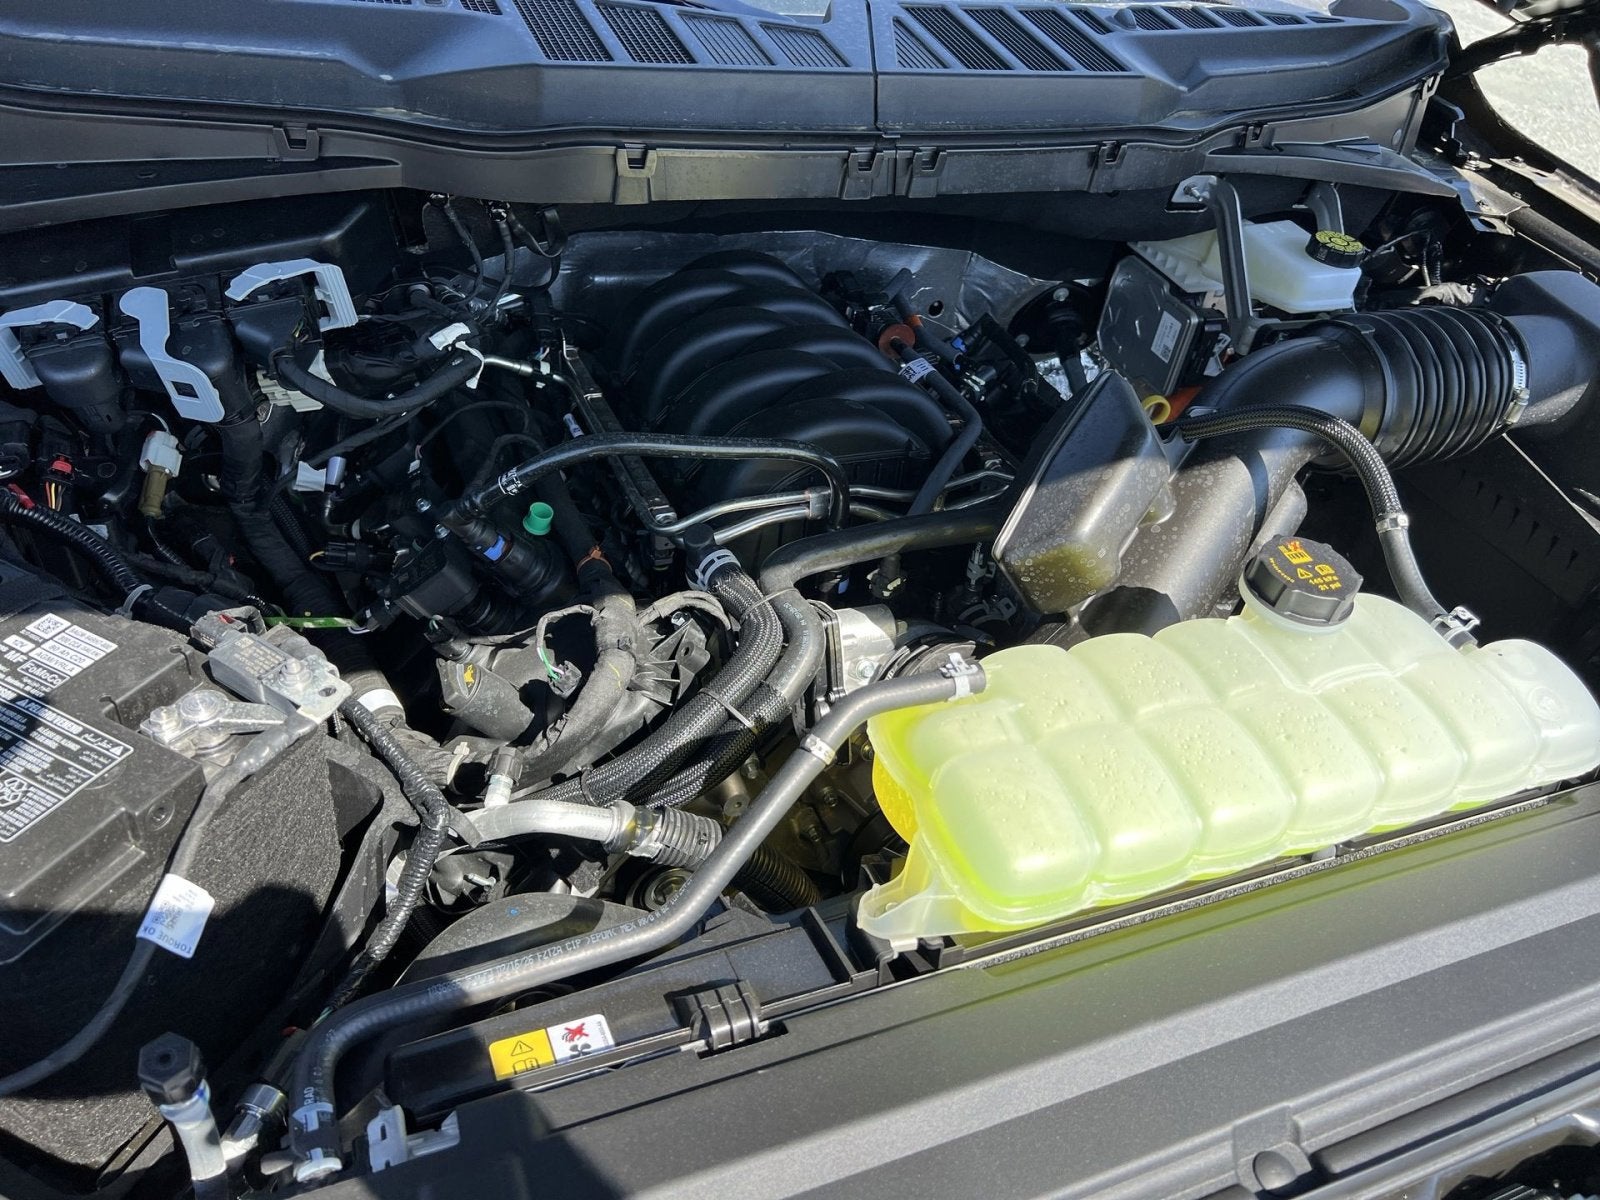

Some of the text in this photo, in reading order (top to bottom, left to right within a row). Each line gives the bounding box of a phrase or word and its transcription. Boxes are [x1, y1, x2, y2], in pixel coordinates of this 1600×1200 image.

[36, 651, 74, 674] AGM/VRLA
[23, 663, 62, 686] FoMoCo
[142, 925, 192, 955] TORQUE OK
[304, 1086, 315, 1106] RAD
